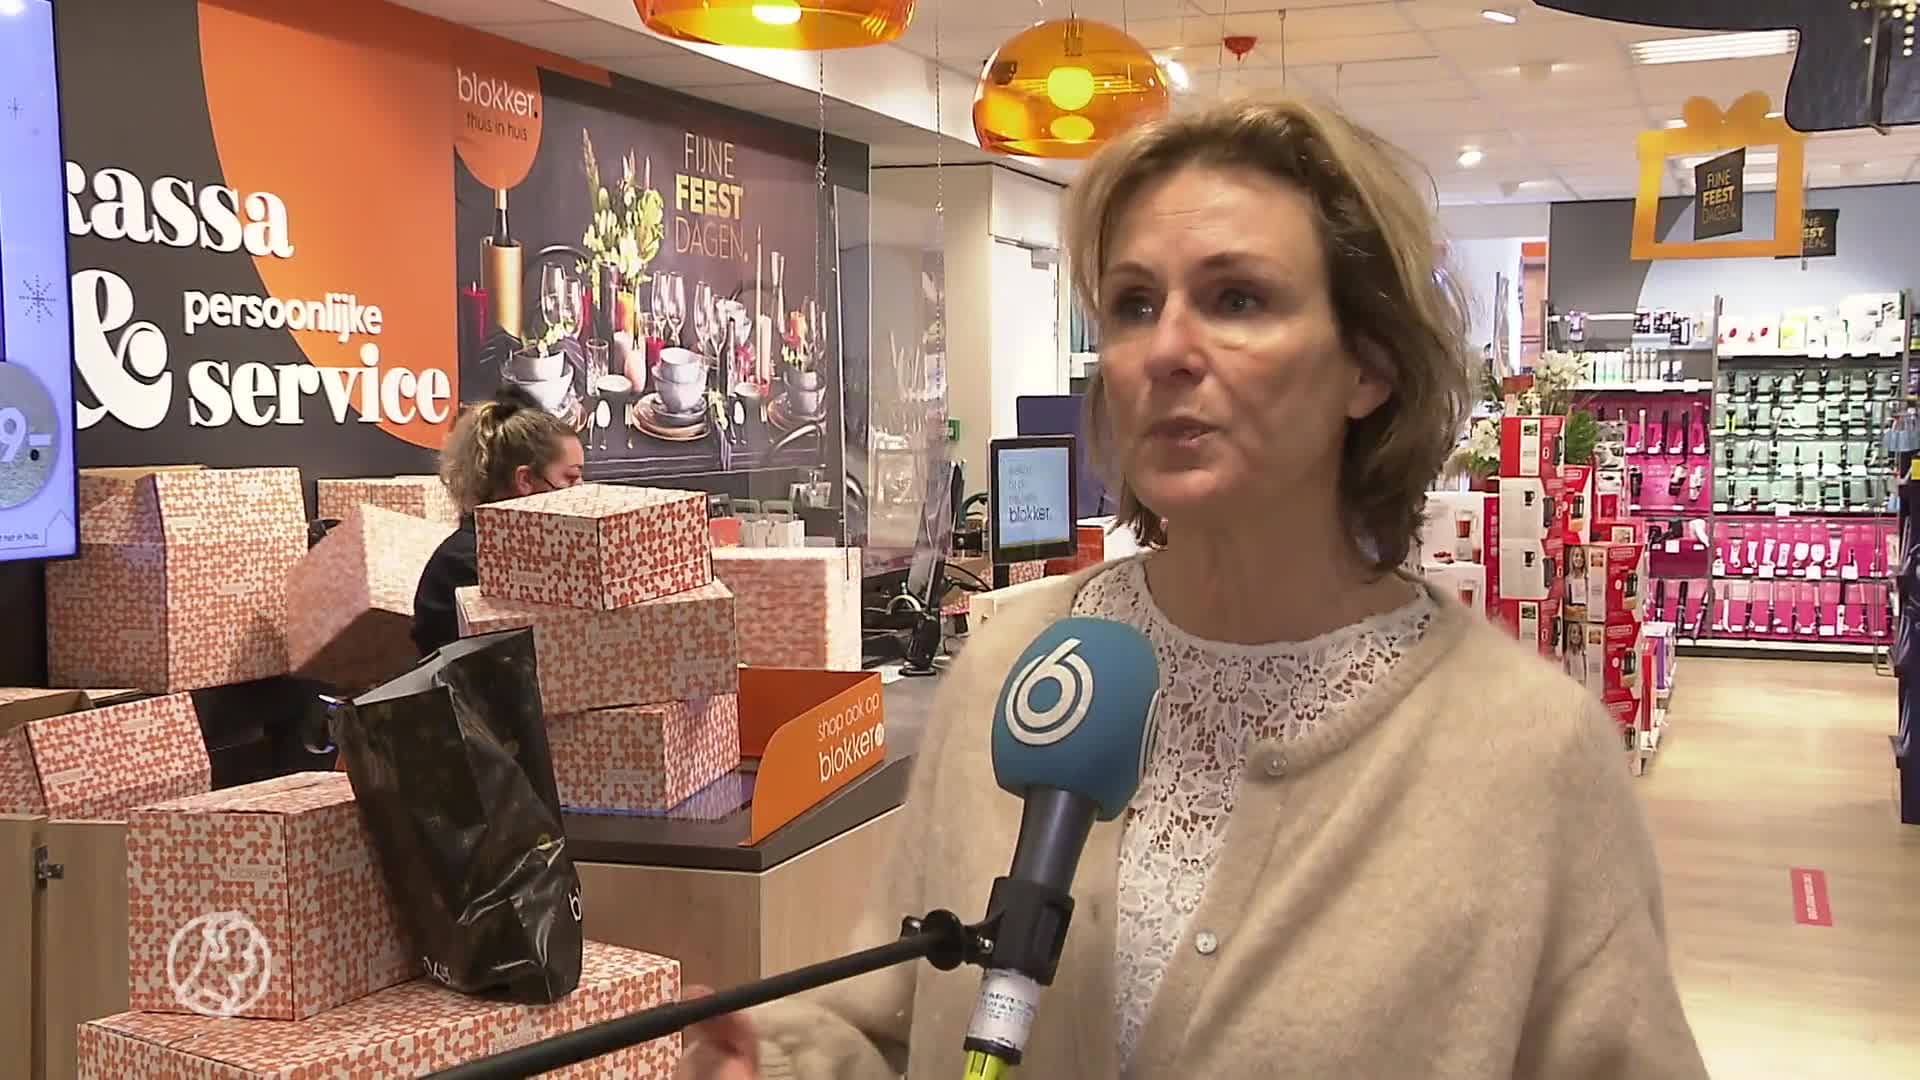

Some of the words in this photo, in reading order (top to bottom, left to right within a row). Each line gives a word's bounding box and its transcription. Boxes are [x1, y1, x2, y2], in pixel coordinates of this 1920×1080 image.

[456, 66, 538, 118] blokker.
[466, 111, 493, 132] thuis
[495, 119, 505, 136] in
[507, 121, 528, 141] huis
[684, 132, 735, 179] FIJNE
[675, 173, 744, 220] FEEST
[1702, 185, 1735, 207] FEEST
[675, 216, 748, 263] DAGEN.
[183, 290, 384, 344] persoonlijke
[72, 268, 174, 430] &
[188, 342, 452, 428] service
[1005, 637, 1096, 746] 6
[818, 713, 844, 742] shop
[845, 697, 865, 726] ook
[865, 692, 880, 717] op
